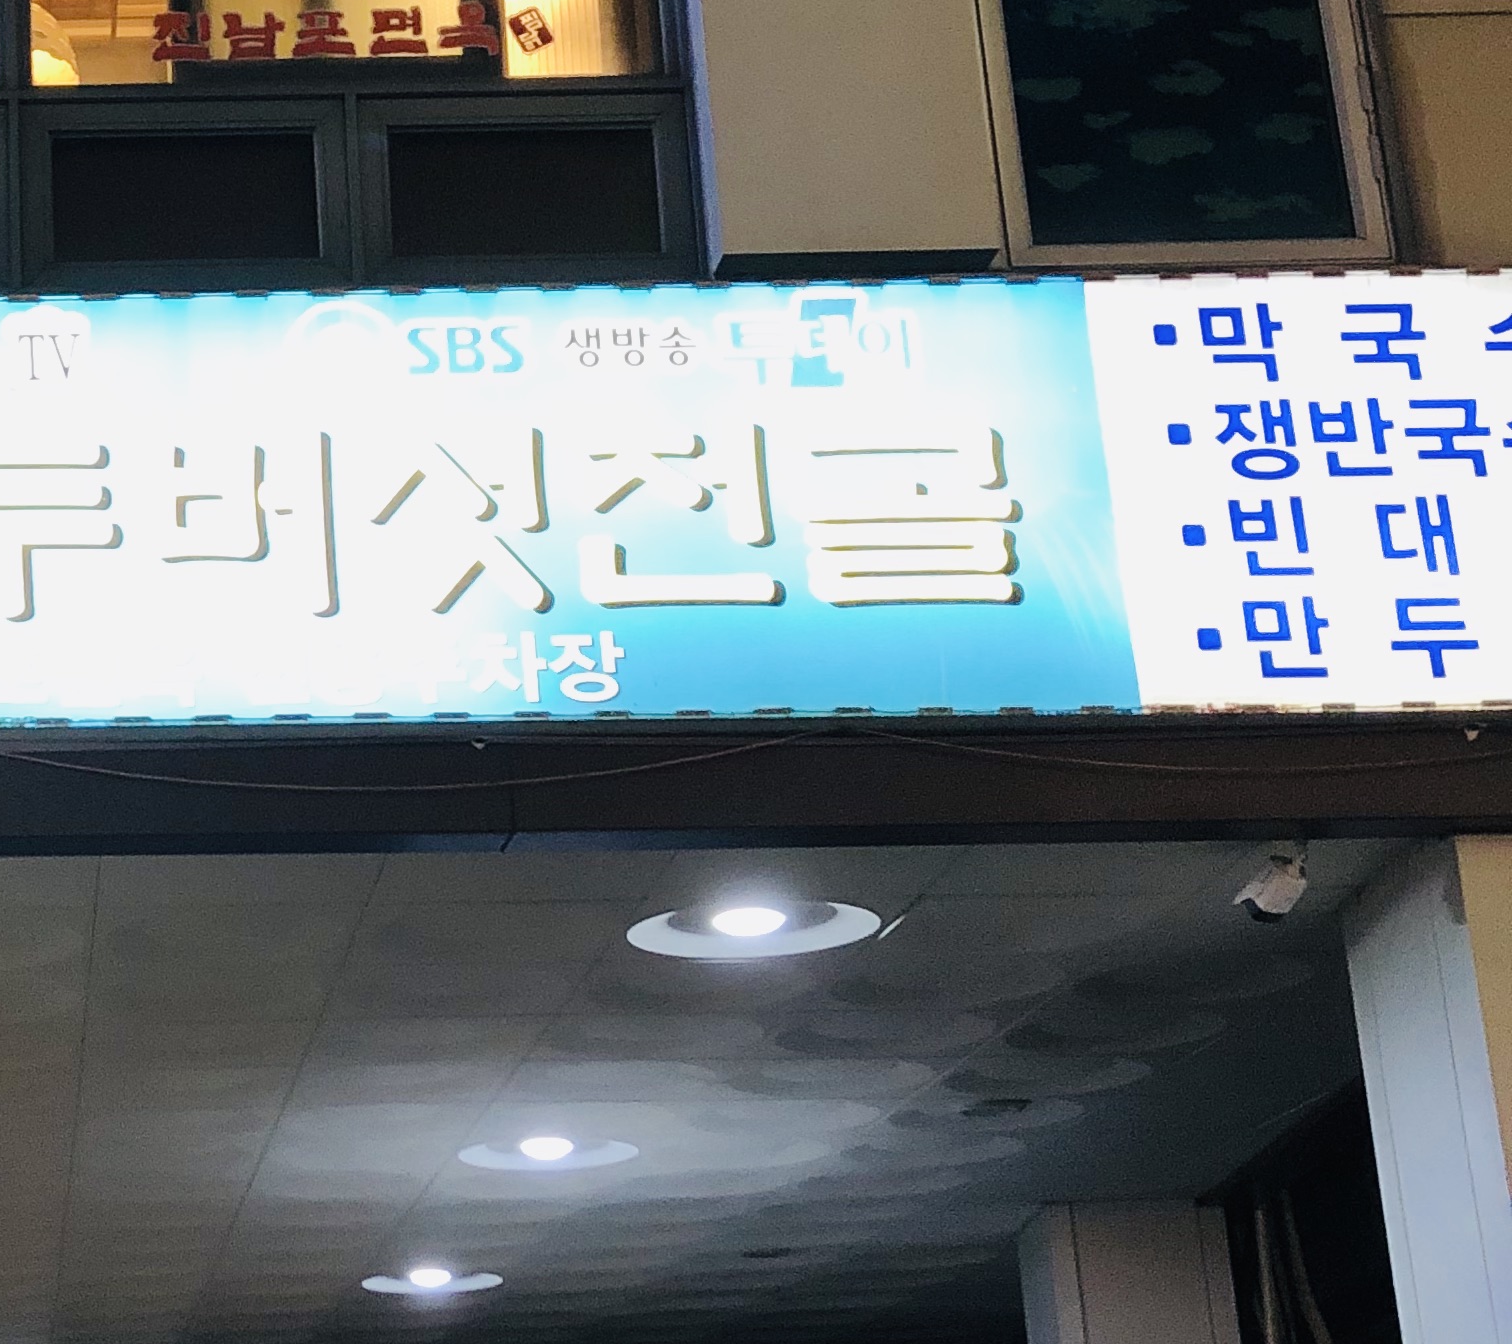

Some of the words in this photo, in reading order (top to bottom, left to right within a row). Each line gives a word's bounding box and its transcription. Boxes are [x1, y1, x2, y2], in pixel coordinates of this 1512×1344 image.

[152, 0, 501, 62] 진남포면옥
[19, 333, 80, 380] TV
[406, 324, 525, 375] SBS
[564, 325, 697, 368] 생방송
[1215, 398, 1512, 481] 쟁반국
